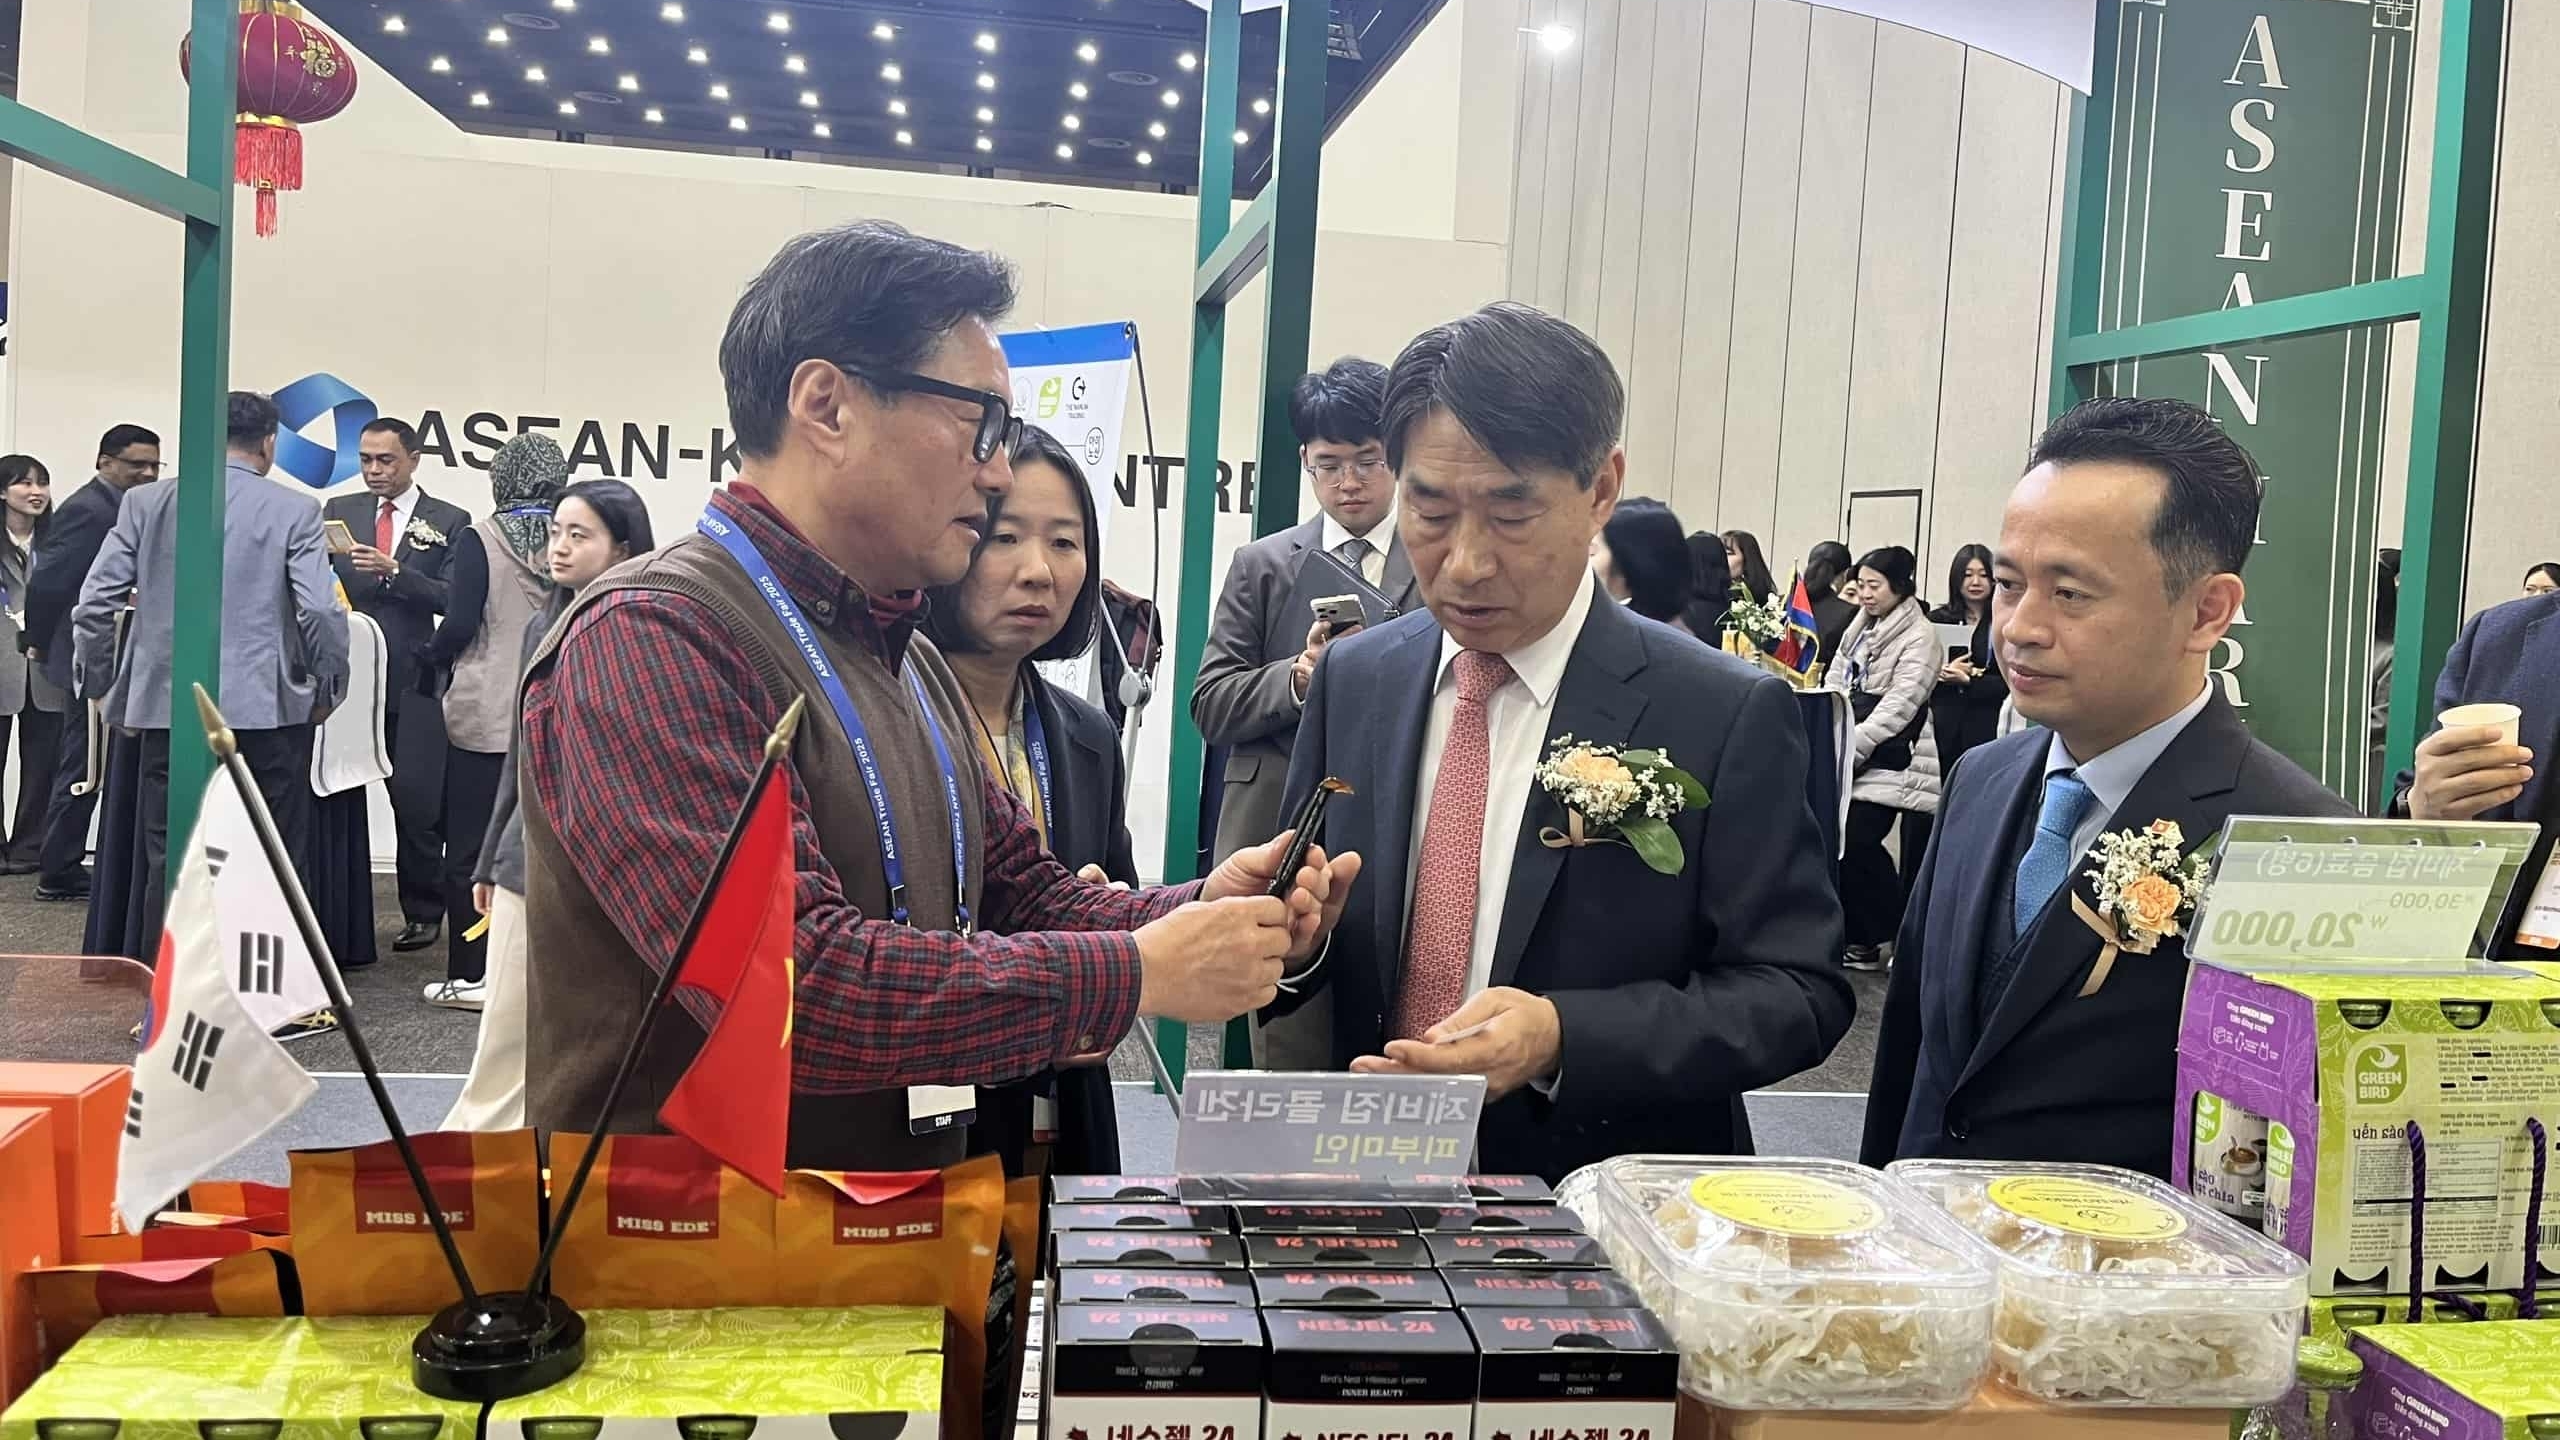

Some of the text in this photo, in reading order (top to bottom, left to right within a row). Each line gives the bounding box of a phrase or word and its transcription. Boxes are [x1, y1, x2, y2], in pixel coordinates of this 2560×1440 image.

[758, 575, 831, 678] ASEAN Trade Fair 2025
[1031, 741, 1044, 760] 2025
[854, 737, 896, 860] ASEAN Trade Fair 2025
[2359, 1071, 2402, 1085] GREEN
[2359, 1085, 2390, 1099] BIRD
[934, 1114, 953, 1128] STAFF
[2381, 1124, 2405, 1139] sào
[2208, 1188, 2235, 1205] chia
[366, 1210, 417, 1225] MISS
[617, 1215, 709, 1233] MISS EDE
[842, 1222, 934, 1238] MISS EDE
[1283, 1273, 1417, 1286] NESJEL 24
[1474, 1277, 1603, 1292] NESJEL 24
[1297, 1318, 1437, 1334] NESJEL 24
[1501, 1316, 1638, 1333] NESJEL 24
[1341, 1388, 1404, 1398] INNER BEAUTY
